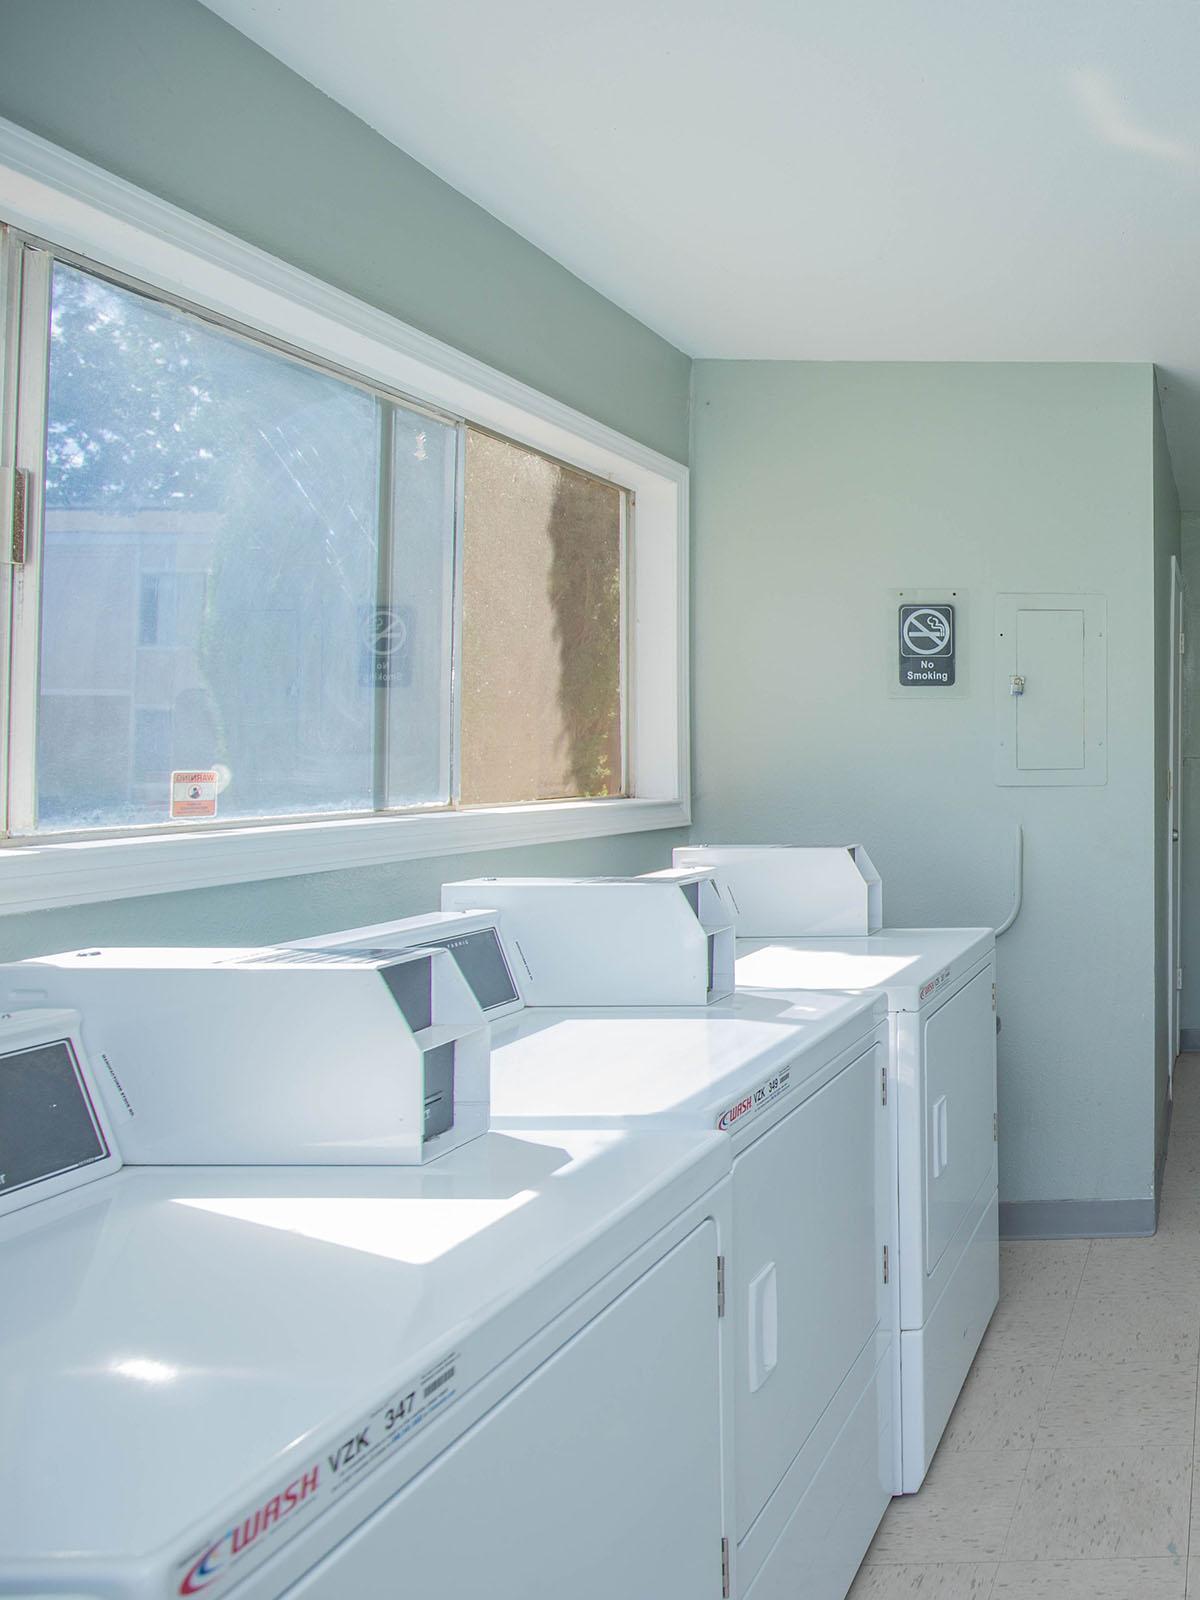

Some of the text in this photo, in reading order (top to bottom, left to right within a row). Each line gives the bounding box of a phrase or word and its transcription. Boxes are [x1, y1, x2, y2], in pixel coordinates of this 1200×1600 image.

[920, 660, 934, 669] No
[907, 671, 948, 682] Smoking
[729, 1095, 753, 1122] WASH
[753, 1086, 766, 1104] VZK
[230, 1464, 320, 1555] WASH
[327, 1426, 370, 1473] VZK
[384, 1390, 416, 1431] 347
